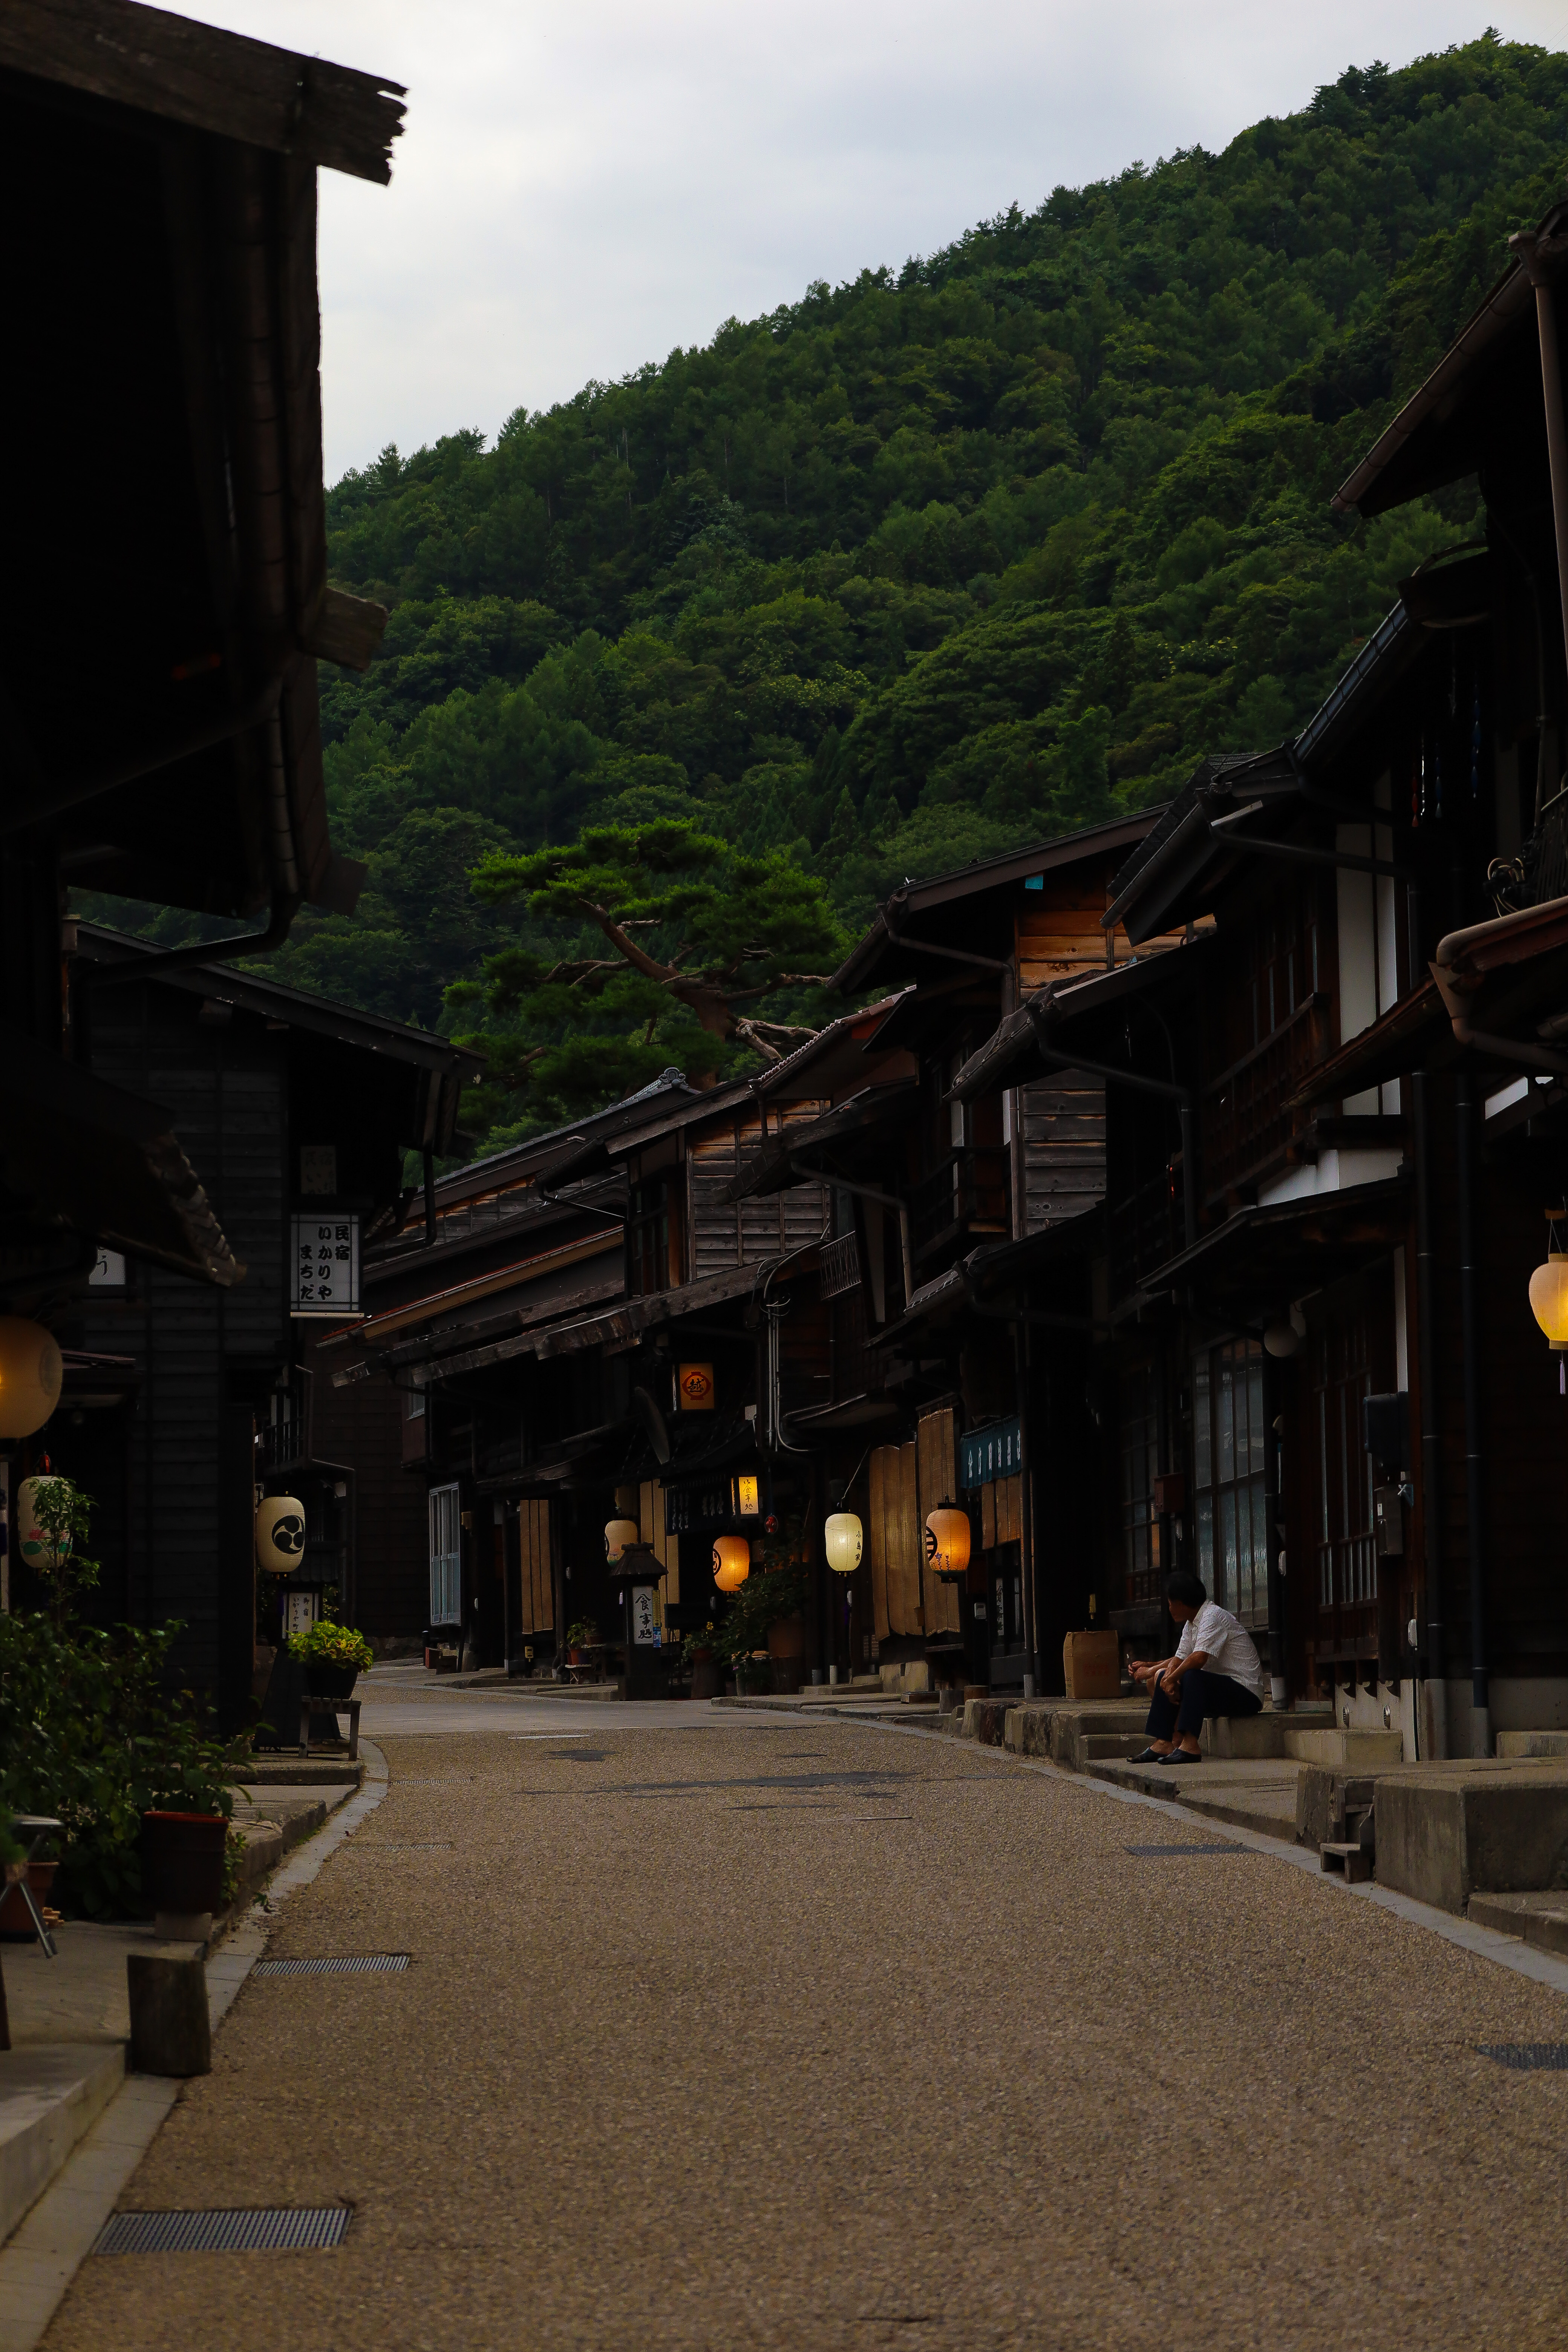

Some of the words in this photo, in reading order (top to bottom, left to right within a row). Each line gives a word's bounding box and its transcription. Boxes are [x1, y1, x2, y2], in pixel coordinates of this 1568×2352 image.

[317, 1225, 332, 1300] いかりや
[335, 1225, 350, 1260] 民宿
[300, 1244, 315, 1300] まちだ
[634, 1593, 652, 1640] 食事処
